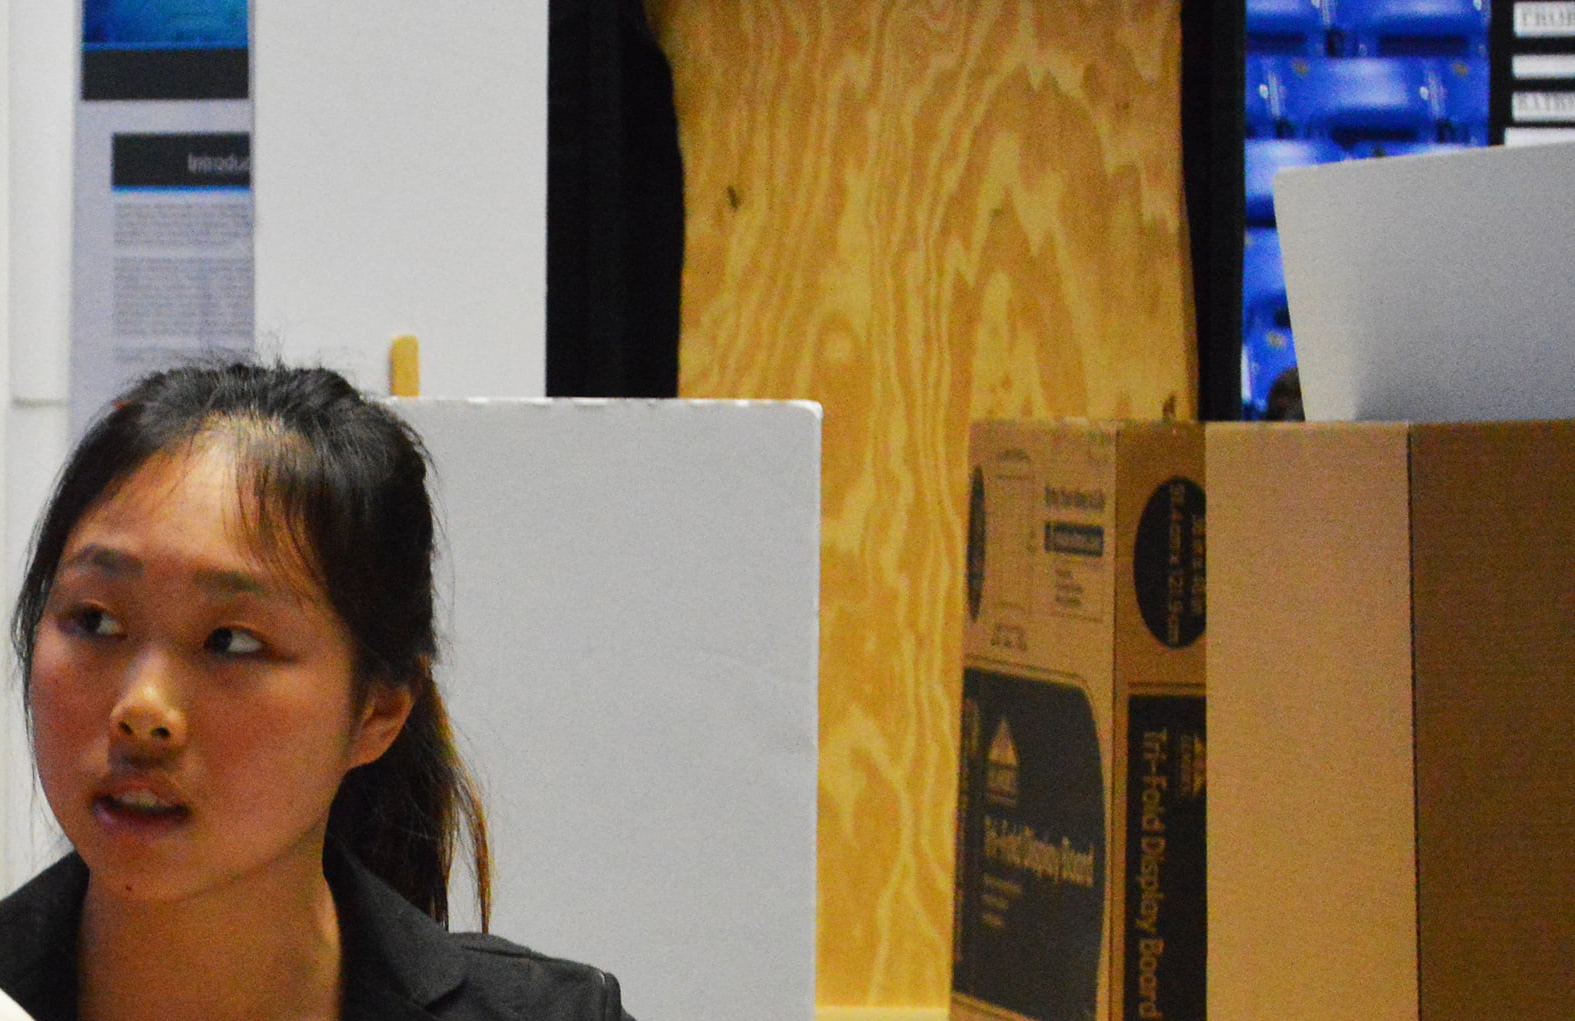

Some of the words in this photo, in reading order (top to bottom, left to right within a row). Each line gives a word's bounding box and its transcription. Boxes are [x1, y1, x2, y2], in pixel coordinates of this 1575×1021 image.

[1142, 728, 1168, 832] Tri-Fold
[1135, 836, 1166, 934] Display
[1138, 938, 1165, 1020] Board
